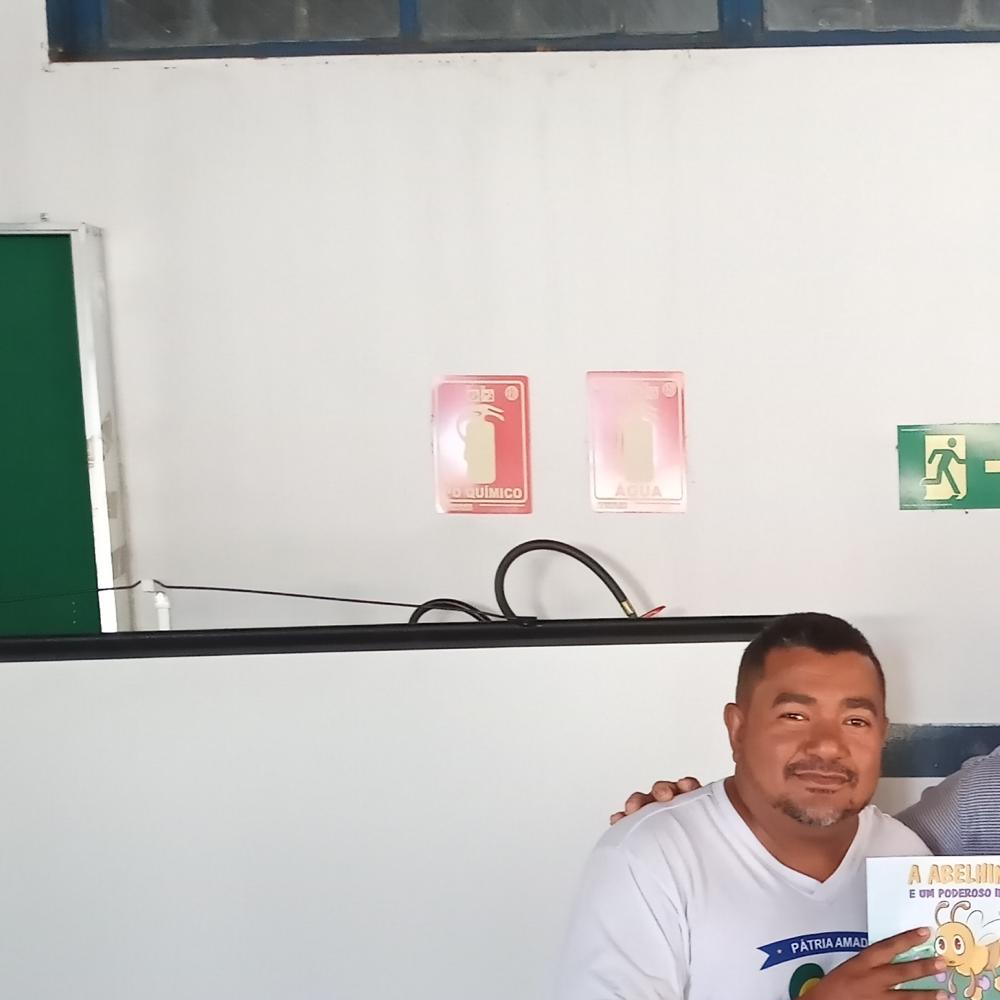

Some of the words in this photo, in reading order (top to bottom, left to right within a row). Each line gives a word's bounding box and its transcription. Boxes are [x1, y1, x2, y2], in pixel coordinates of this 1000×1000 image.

[465, 485, 522, 498] QUÍMICO
[908, 864, 921, 885] A
[909, 889, 916, 898] E
[919, 889, 935, 898] UM
[938, 888, 991, 898] PODEROSO
[834, 936, 868, 948] AMAD
